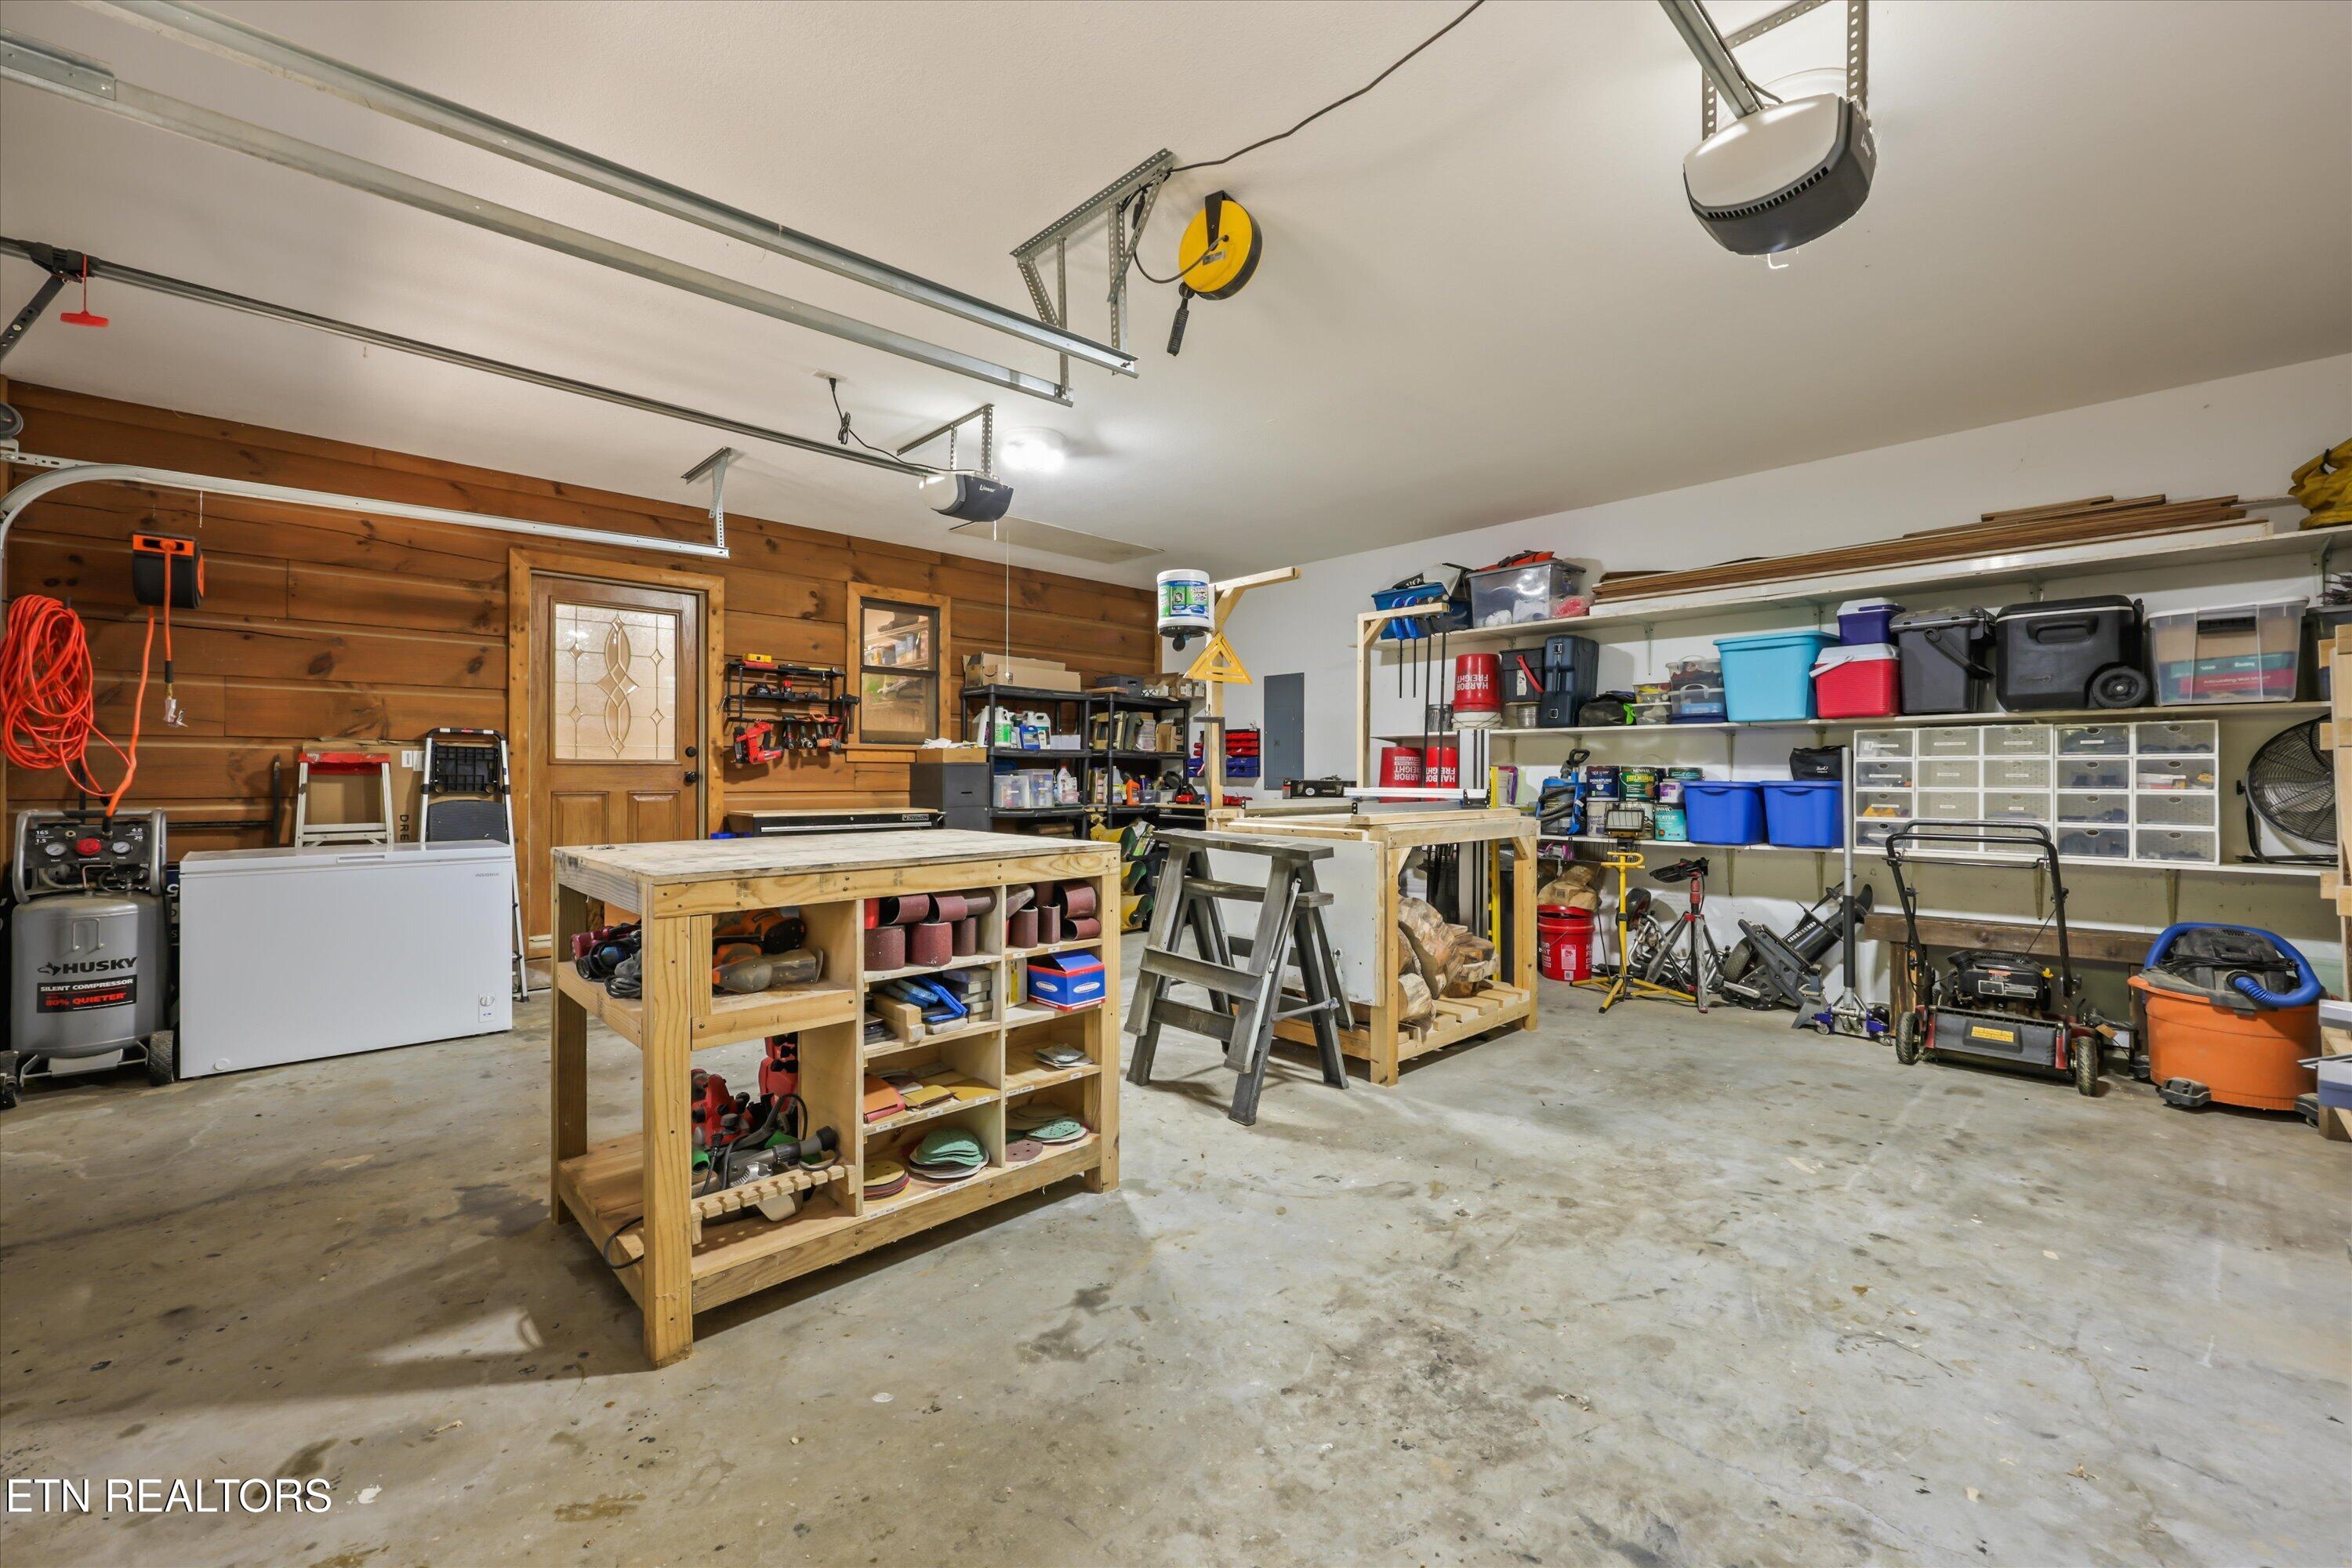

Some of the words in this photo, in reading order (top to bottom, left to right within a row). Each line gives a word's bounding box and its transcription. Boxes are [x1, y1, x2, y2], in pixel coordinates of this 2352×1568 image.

[1457, 674, 1489, 683] FREIGHT
[1457, 681, 1488, 691] HARBOR
[63, 957, 137, 974] HUSKY
[72, 978, 133, 990] COMPRESSOR
